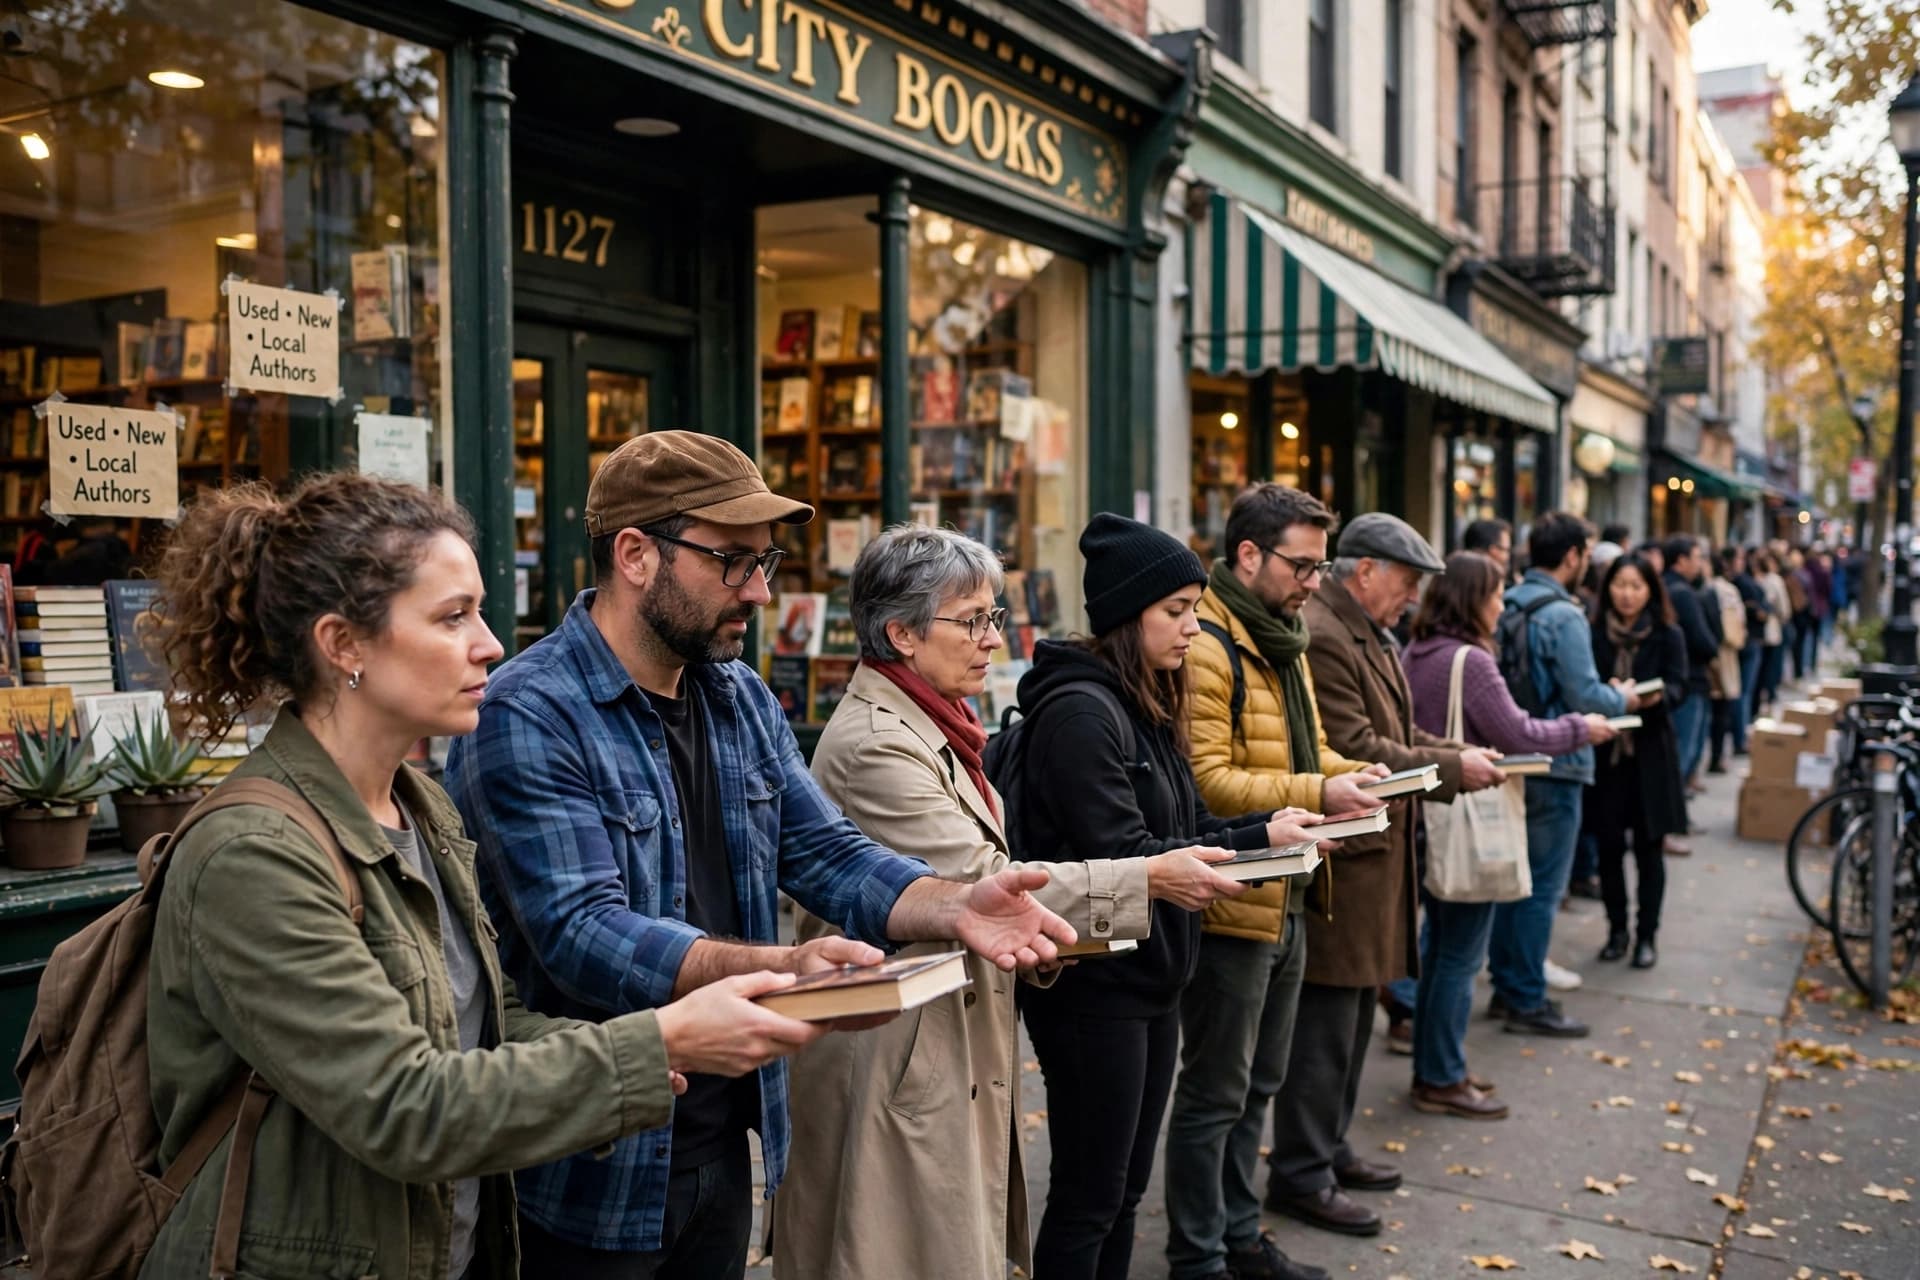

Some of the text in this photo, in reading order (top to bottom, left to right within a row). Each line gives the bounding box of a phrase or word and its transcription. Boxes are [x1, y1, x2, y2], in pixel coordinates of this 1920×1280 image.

[703, 0, 1064, 187] CITY BOOKS
[522, 202, 616, 268] 1127
[238, 295, 332, 328] Used New
[262, 328, 306, 353] Local
[250, 354, 316, 382] Authors
[58, 415, 166, 445] Used New
[86, 448, 137, 473] Local
[73, 477, 151, 504] Authors
